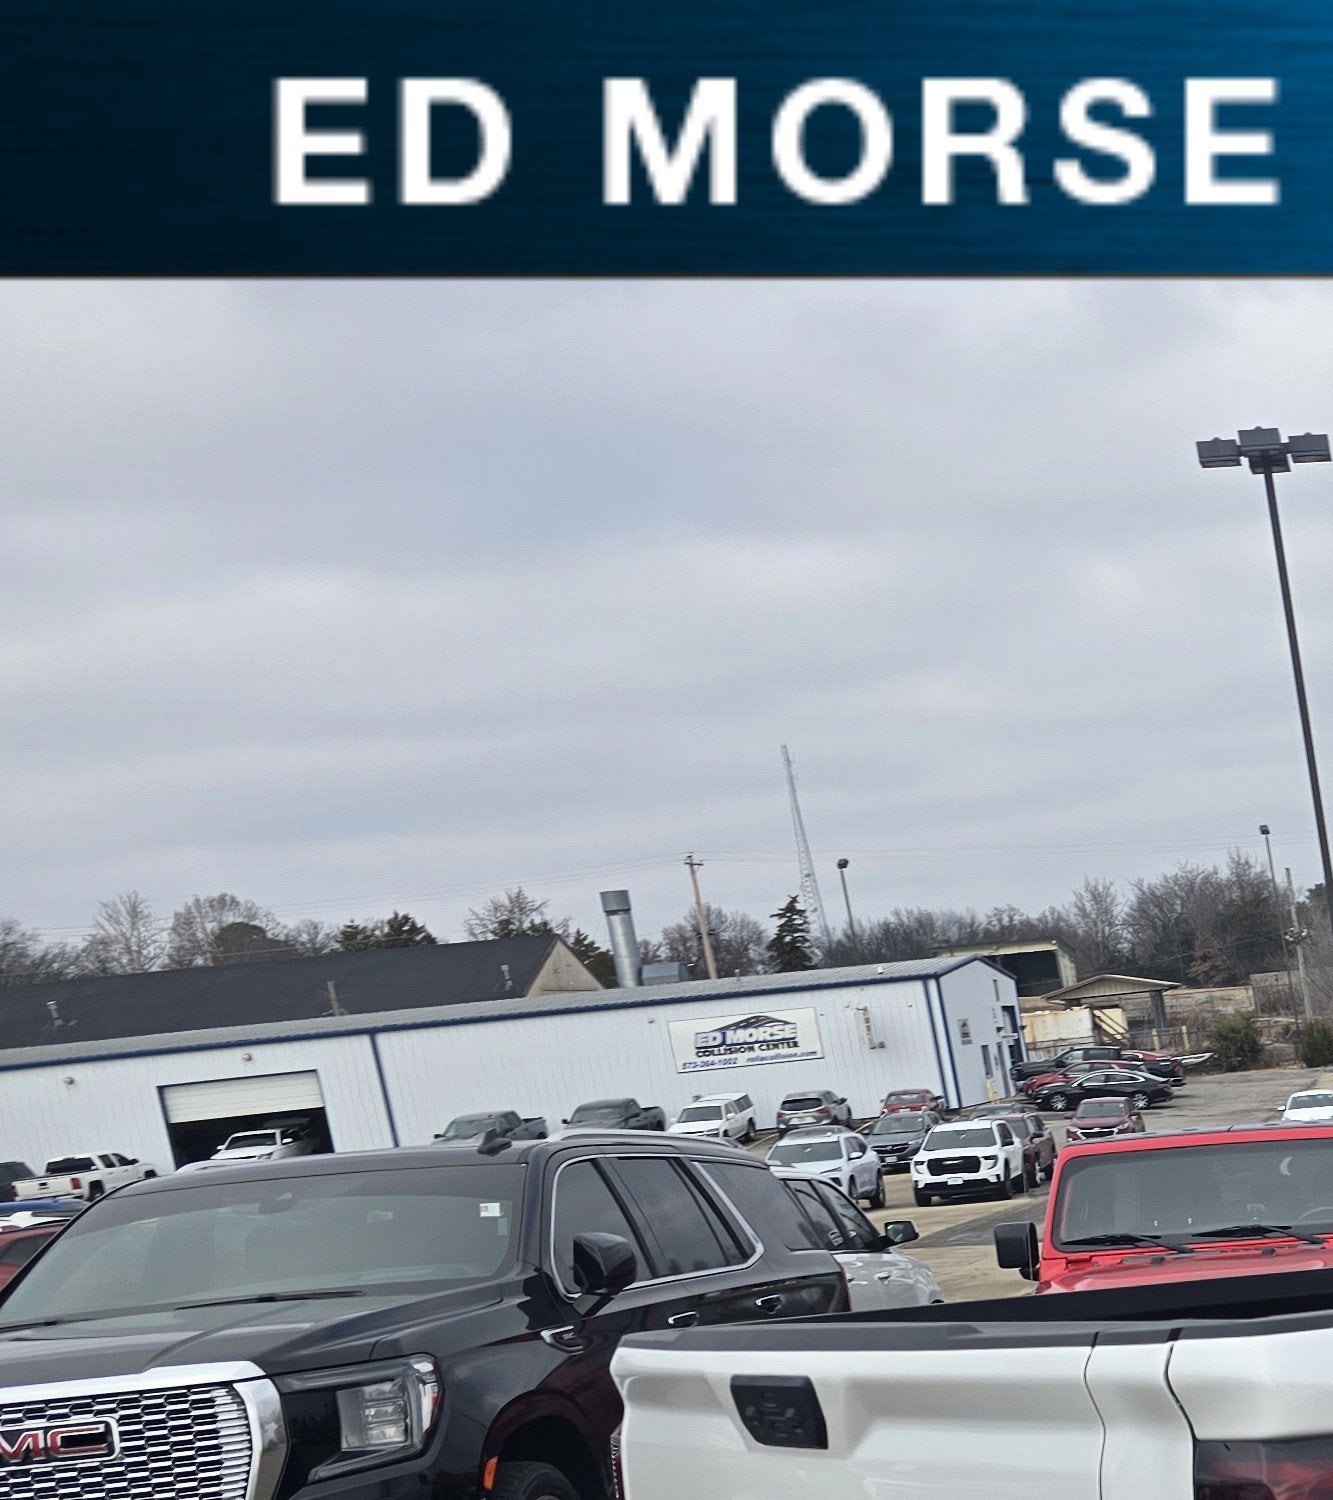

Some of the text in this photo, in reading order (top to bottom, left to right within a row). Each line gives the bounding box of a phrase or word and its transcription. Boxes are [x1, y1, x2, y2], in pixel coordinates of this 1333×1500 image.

[695, 1023, 797, 1049] ED MORSE
[695, 1040, 800, 1058] COLLISION CENTER
[0, 1422, 109, 1463] MC
